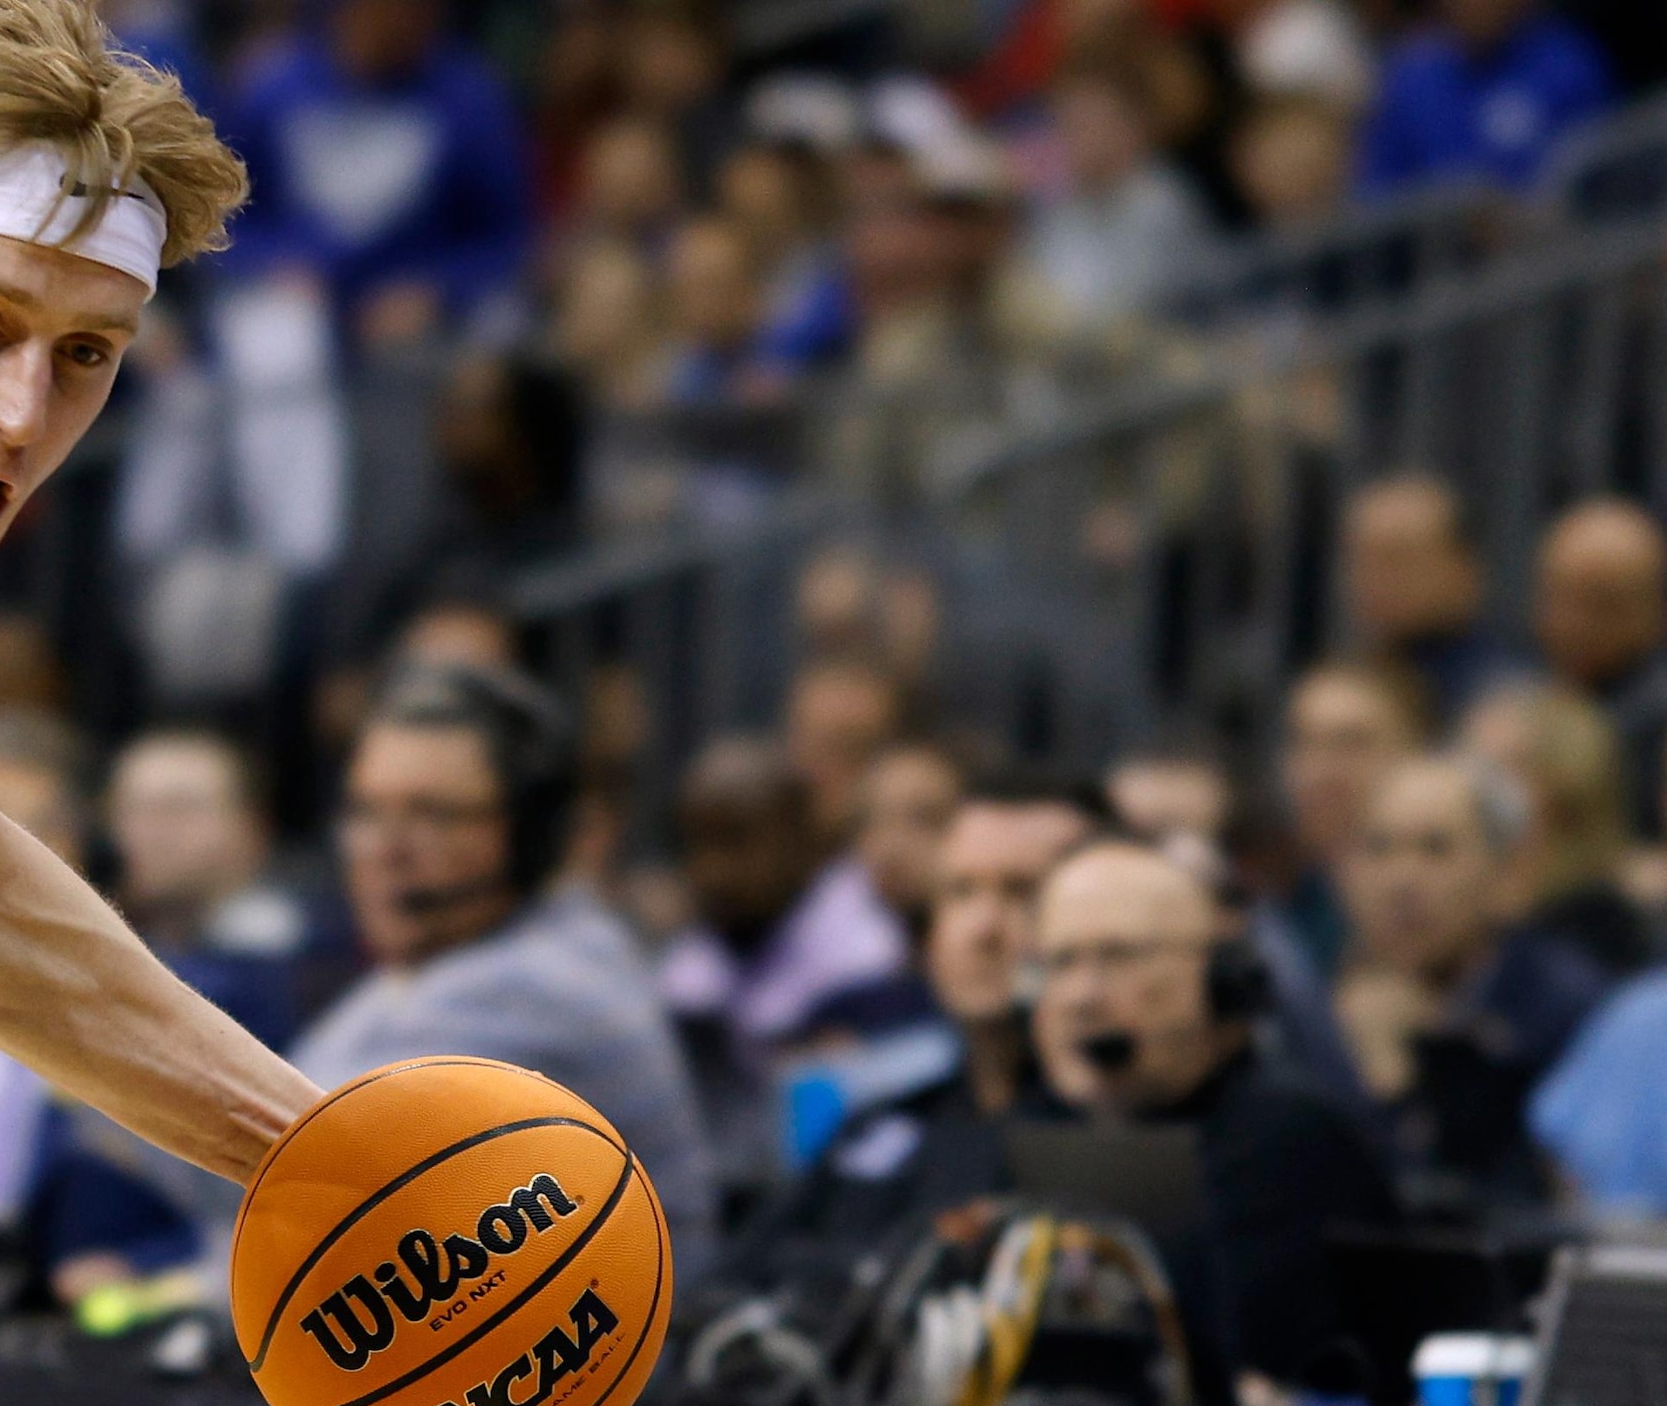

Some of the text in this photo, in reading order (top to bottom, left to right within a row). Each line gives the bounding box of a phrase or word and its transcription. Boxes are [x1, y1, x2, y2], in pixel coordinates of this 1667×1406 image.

[298, 1172, 579, 1373] Wilson
[429, 1270, 507, 1332] EVO NXT
[589, 1332, 627, 1374] BALL
